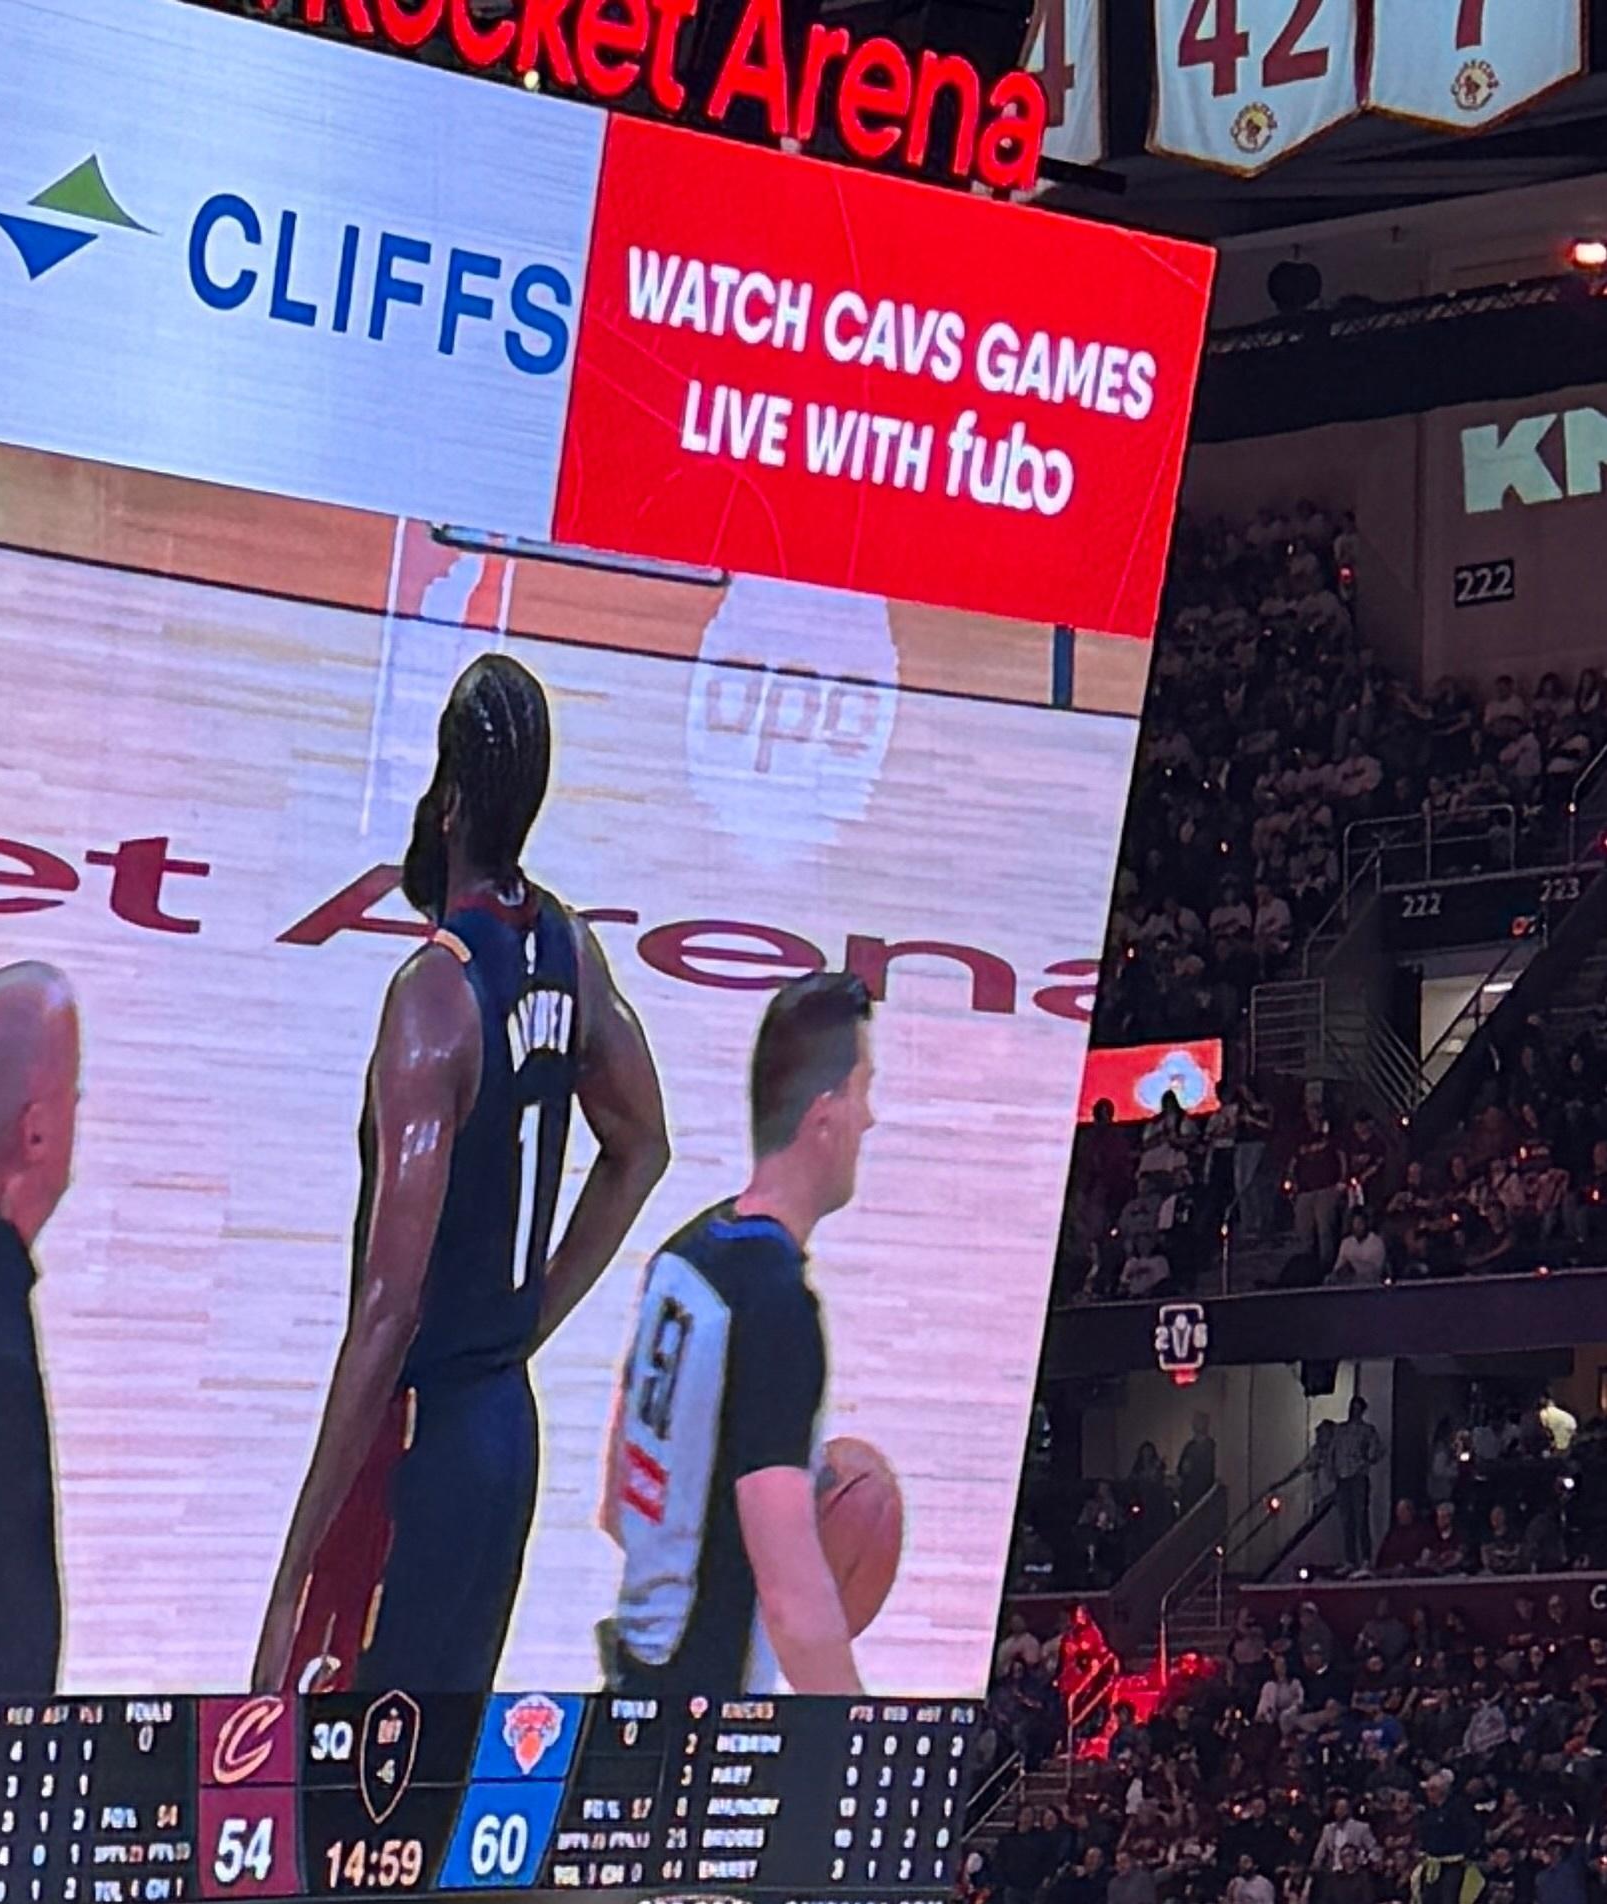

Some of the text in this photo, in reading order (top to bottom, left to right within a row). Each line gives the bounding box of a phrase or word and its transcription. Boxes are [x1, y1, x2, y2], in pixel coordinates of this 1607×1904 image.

[704, 0, 1052, 192] Arena
[187, 192, 574, 377] CLIFFS
[627, 246, 1156, 422] WATCH CAVS GAMES
[680, 382, 1075, 516] LIVE WITH fubo
[1455, 561, 1514, 600] 222
[1402, 894, 1442, 918] 222
[214, 1817, 273, 1883] 54
[326, 1840, 423, 1888] 14:59
[471, 1814, 528, 1875] 60
